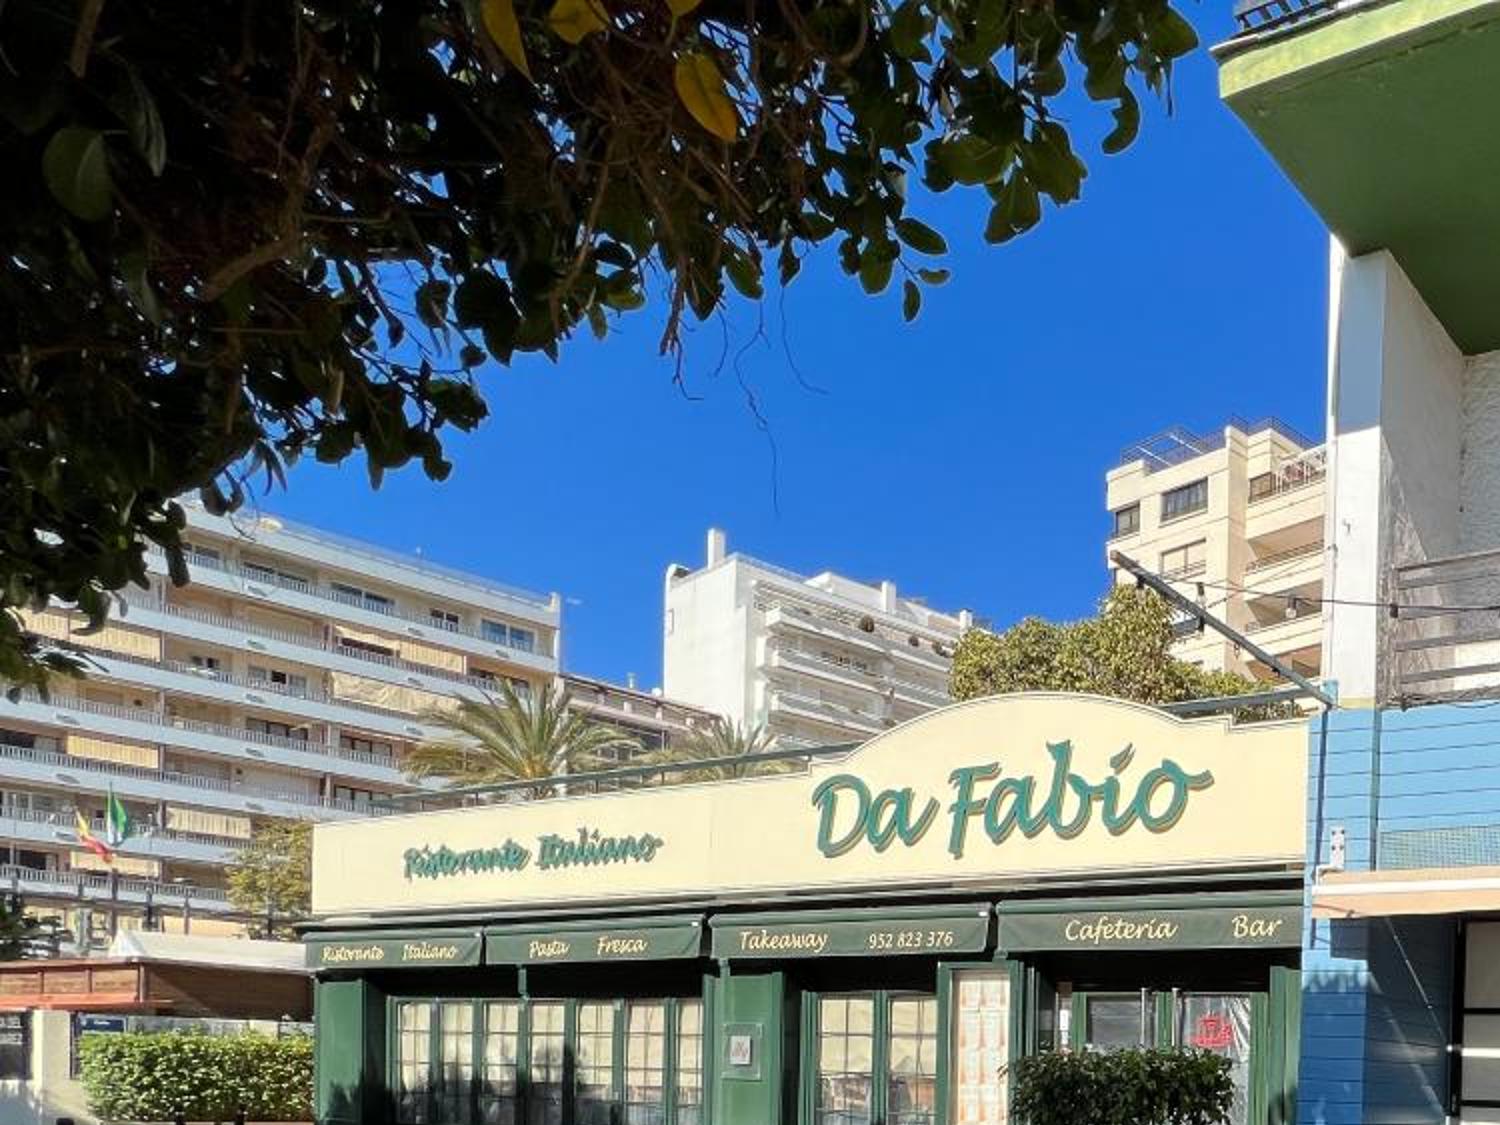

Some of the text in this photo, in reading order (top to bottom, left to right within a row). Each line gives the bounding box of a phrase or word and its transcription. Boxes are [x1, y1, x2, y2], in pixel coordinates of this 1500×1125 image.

[811, 772, 941, 859] Da
[403, 826, 665, 883] Ristorante Italiano
[1231, 914, 1283, 939] Bar
[321, 941, 458, 962] Ristorante Italiano
[529, 934, 649, 959] Pasta Fresca
[739, 929, 829, 952] Takeaway
[868, 931, 953, 949] 952 823 376
